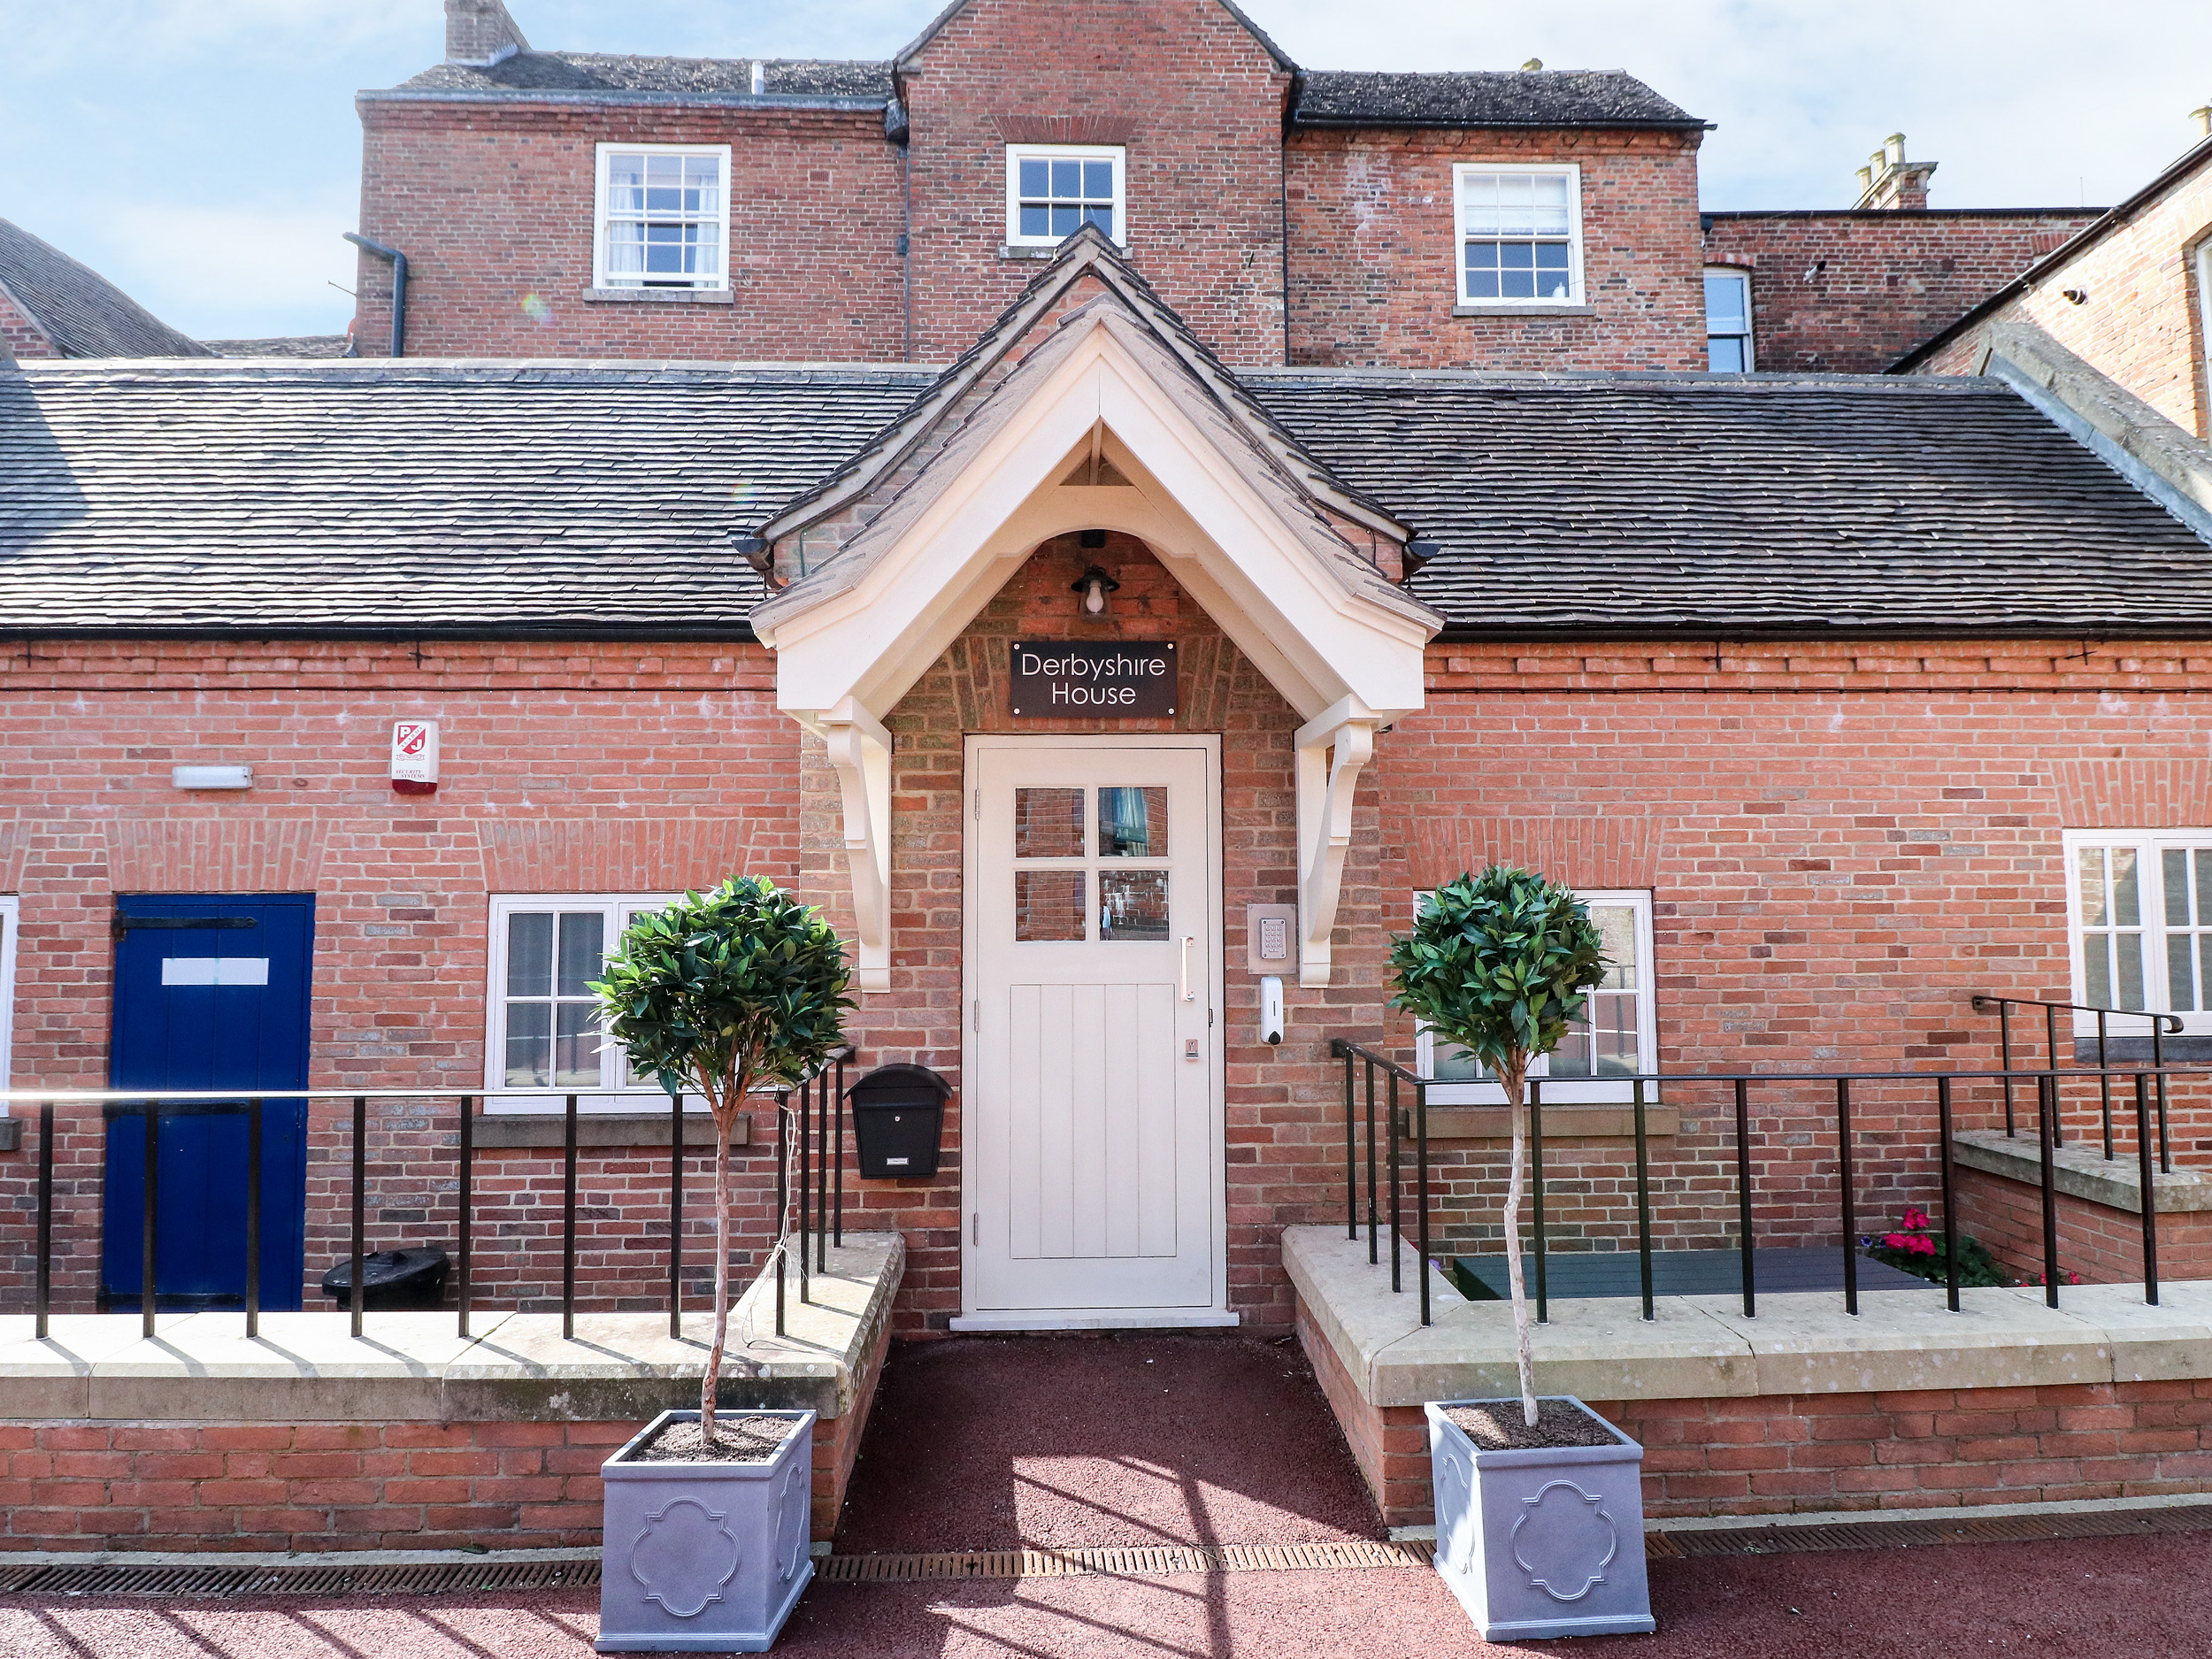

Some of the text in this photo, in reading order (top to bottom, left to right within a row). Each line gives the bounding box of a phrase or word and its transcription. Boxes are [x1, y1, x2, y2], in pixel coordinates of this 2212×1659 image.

[1022, 653, 1166, 681] Derbyshire
[1052, 682, 1137, 705] House
[400, 726, 411, 738] P
[411, 739, 423, 750] J
